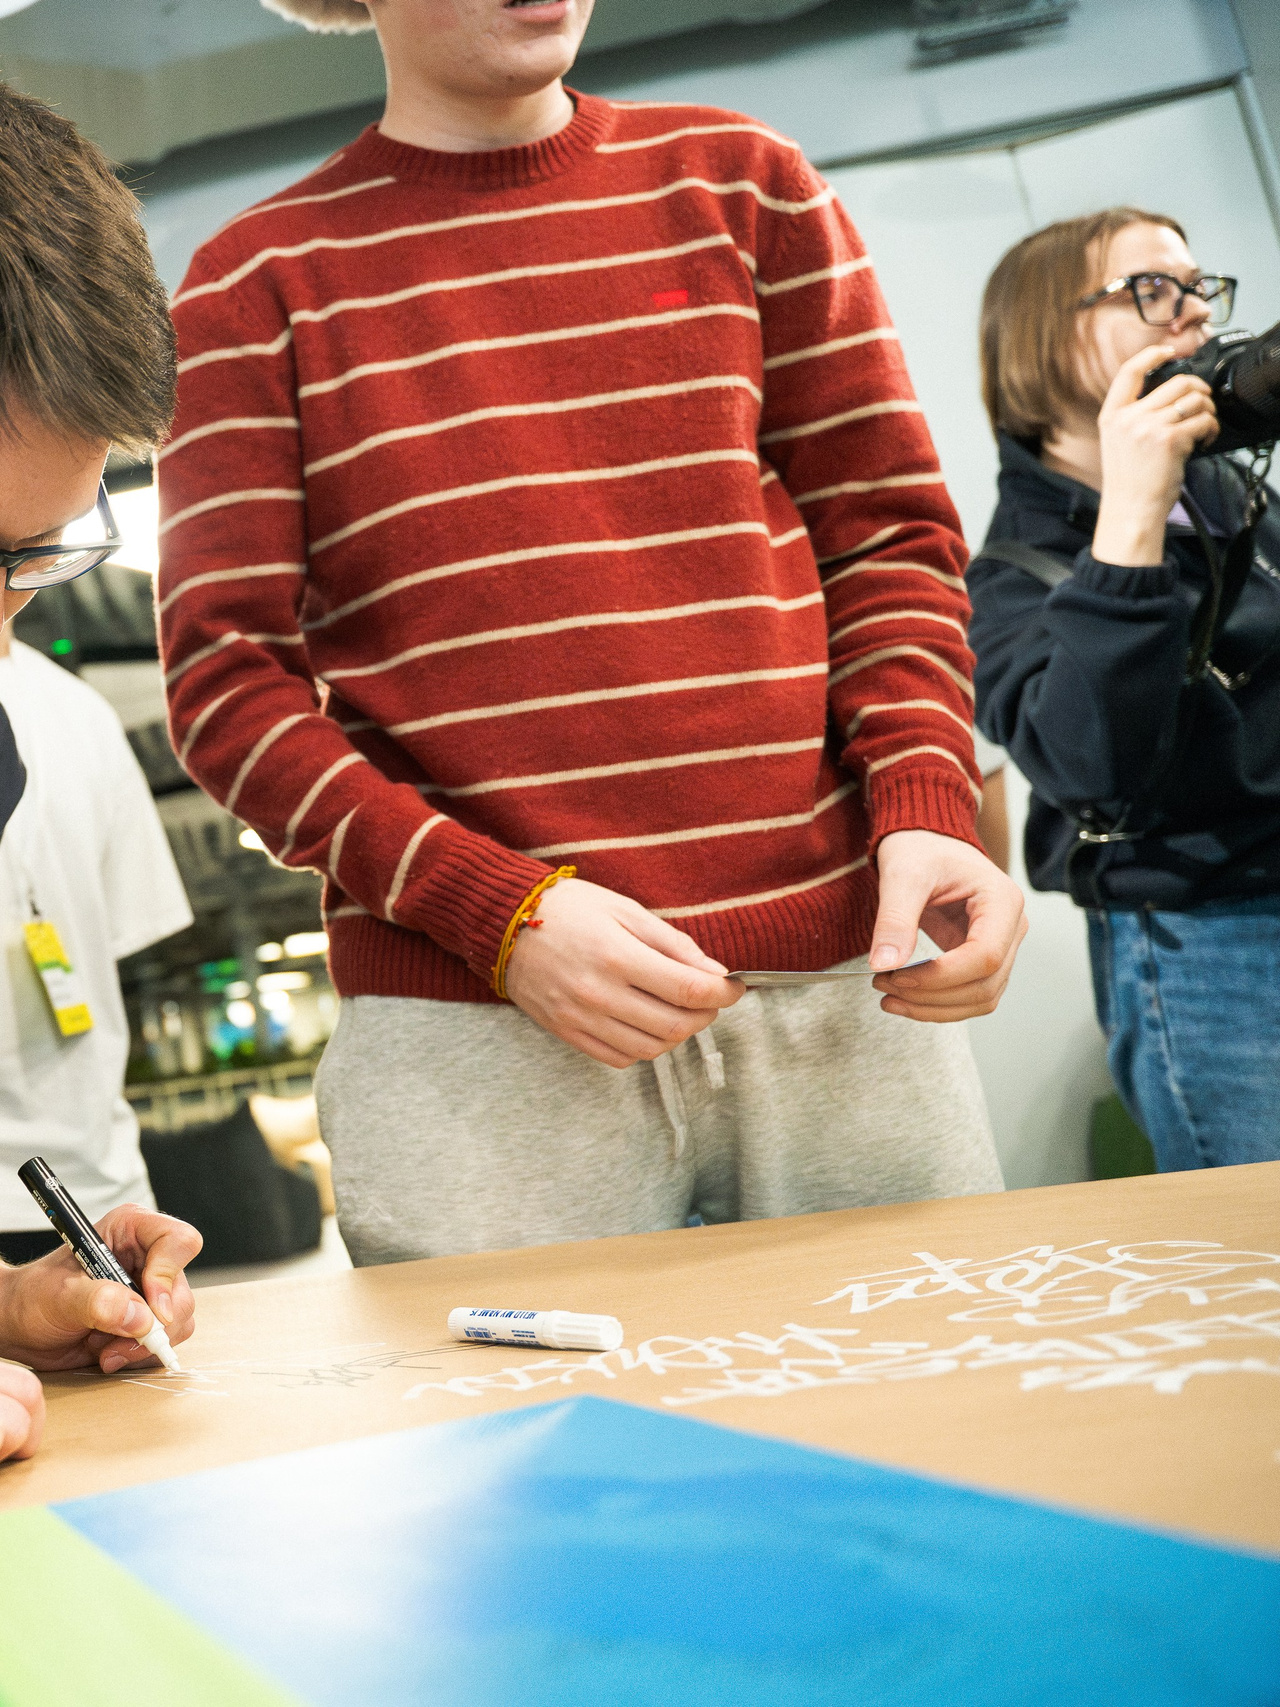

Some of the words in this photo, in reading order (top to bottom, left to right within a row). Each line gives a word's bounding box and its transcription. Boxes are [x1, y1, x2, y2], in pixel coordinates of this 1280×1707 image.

[469, 1309, 479, 1317] IS
[477, 1309, 500, 1317] NAME
[500, 1309, 515, 1318] MY
[513, 1310, 538, 1320] HELLO
